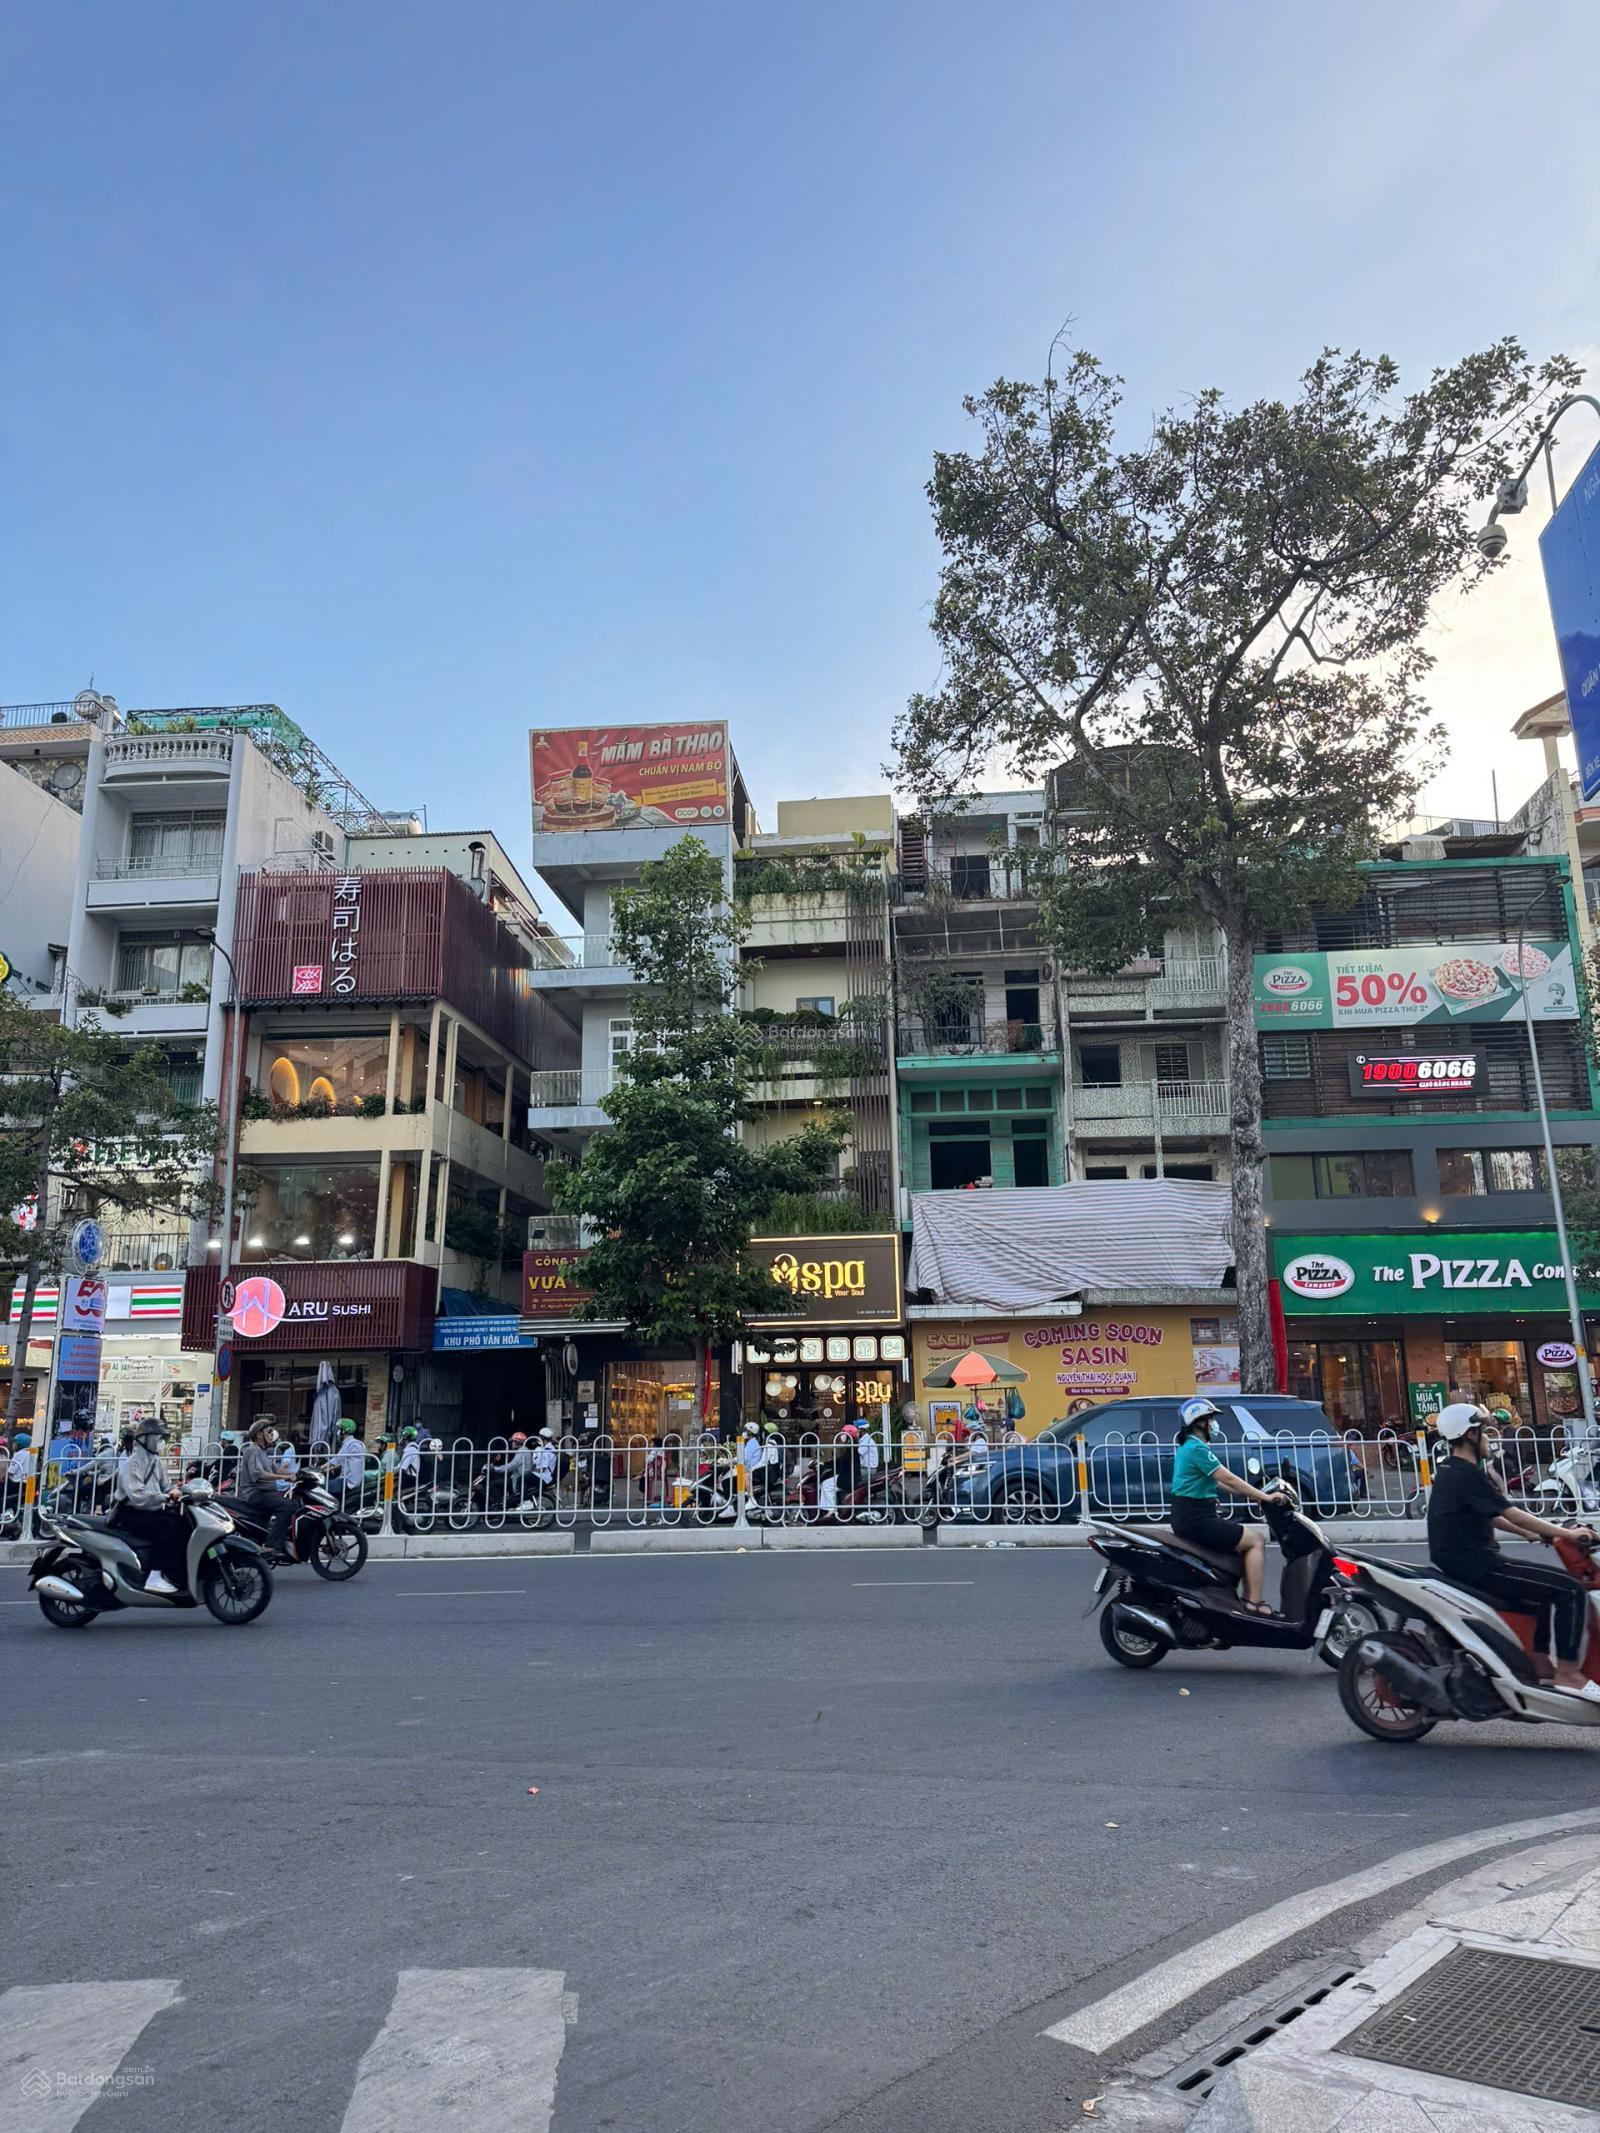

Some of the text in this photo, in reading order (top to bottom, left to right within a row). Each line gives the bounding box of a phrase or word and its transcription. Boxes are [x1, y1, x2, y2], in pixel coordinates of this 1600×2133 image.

[601, 731, 723, 766] MẮM BÀ THẠO
[681, 762, 704, 773] NAM
[706, 759, 722, 773] BỘ
[330, 875, 362, 994] 寿司はる
[1336, 962, 1356, 974] TIẾT
[1272, 974, 1306, 984] PIZZA
[1336, 972, 1428, 1007] 50%
[1354, 1007, 1373, 1015] MUA
[1374, 1006, 1400, 1014] PIZZA
[1361, 1060, 1477, 1081] 19006066
[535, 1255, 568, 1266] CÔNG
[1296, 1267, 1342, 1280] PIZZA
[1373, 1266, 1405, 1281] The
[1408, 1253, 1533, 1289] PIZZA
[528, 1275, 567, 1293] VỰA
[834, 1289, 849, 1297] Your
[332, 1304, 371, 1315] SUSHI
[444, 1337, 461, 1347] KHU
[463, 1333, 481, 1346] PHỐ
[483, 1335, 501, 1345] VĂN
[1023, 1323, 1101, 1348] COMING
[1105, 1322, 1164, 1346] SOON
[1061, 1346, 1129, 1366] SASIN
[1544, 1349, 1572, 1357] PIZZA
[1416, 1393, 1434, 1402] MUA
[1417, 1400, 1438, 1414] TẶNG
